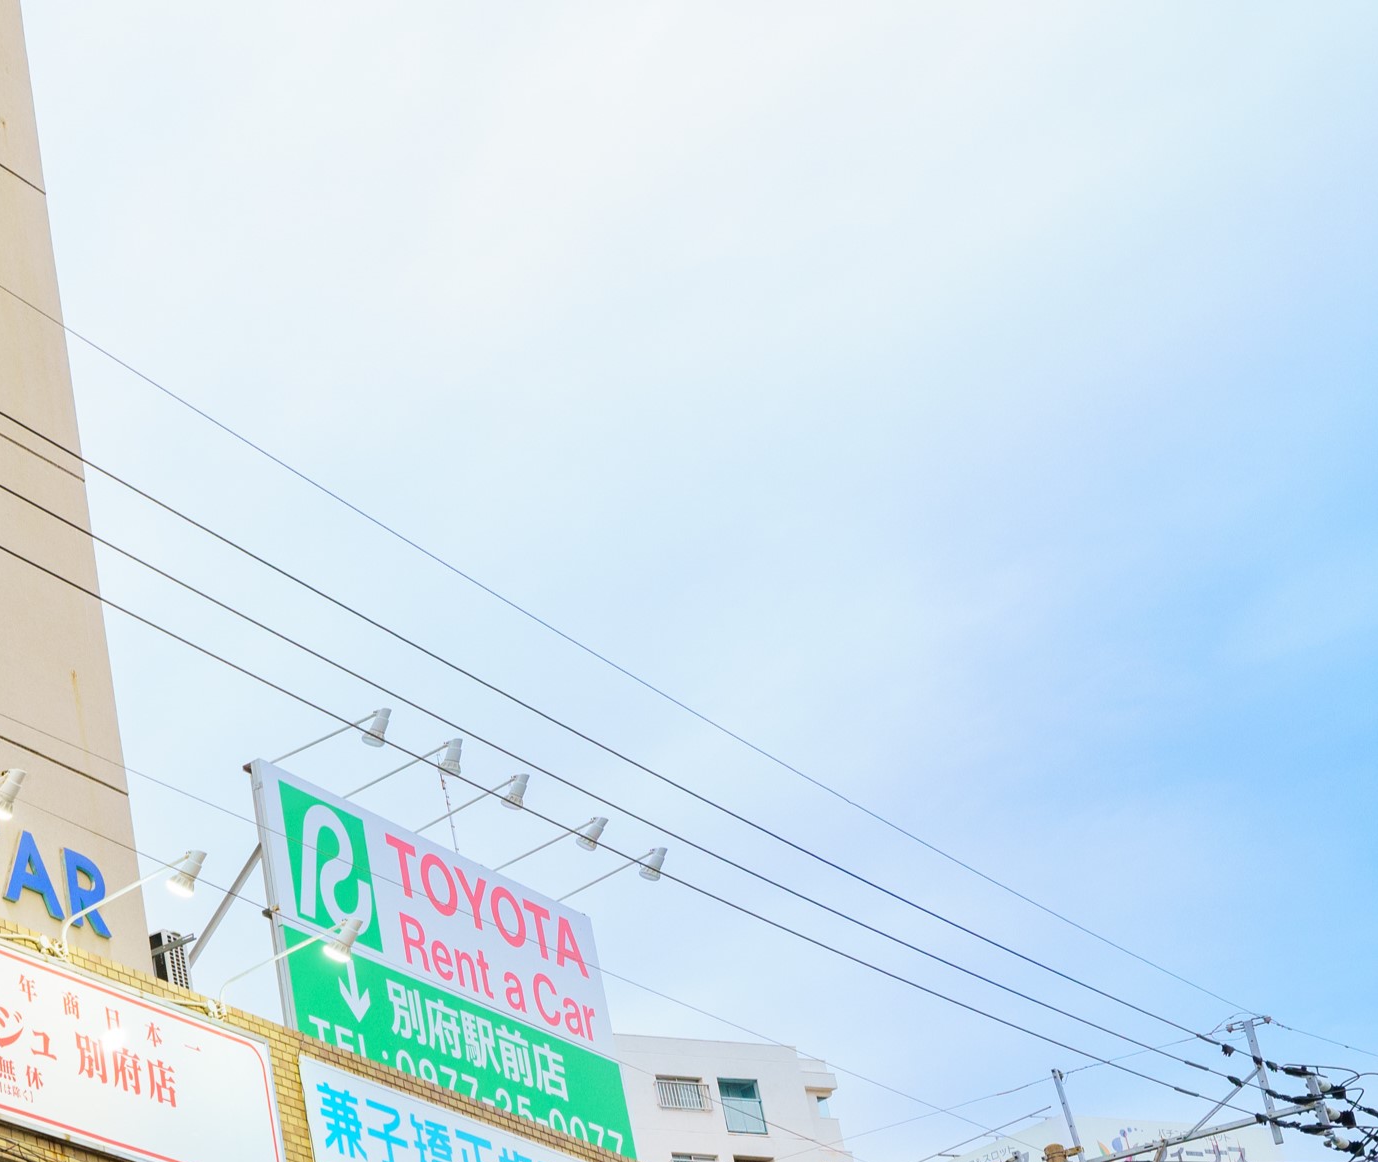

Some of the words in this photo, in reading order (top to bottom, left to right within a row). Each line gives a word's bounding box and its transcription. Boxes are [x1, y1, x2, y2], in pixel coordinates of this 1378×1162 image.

[385, 833, 590, 980] TOYOTA
[399, 912, 494, 999] Rent
[505, 971, 528, 1014] a
[533, 973, 596, 1042] Car
[75, 1031, 177, 1109] 別府店
[386, 979, 570, 1102] 別府駅前店
